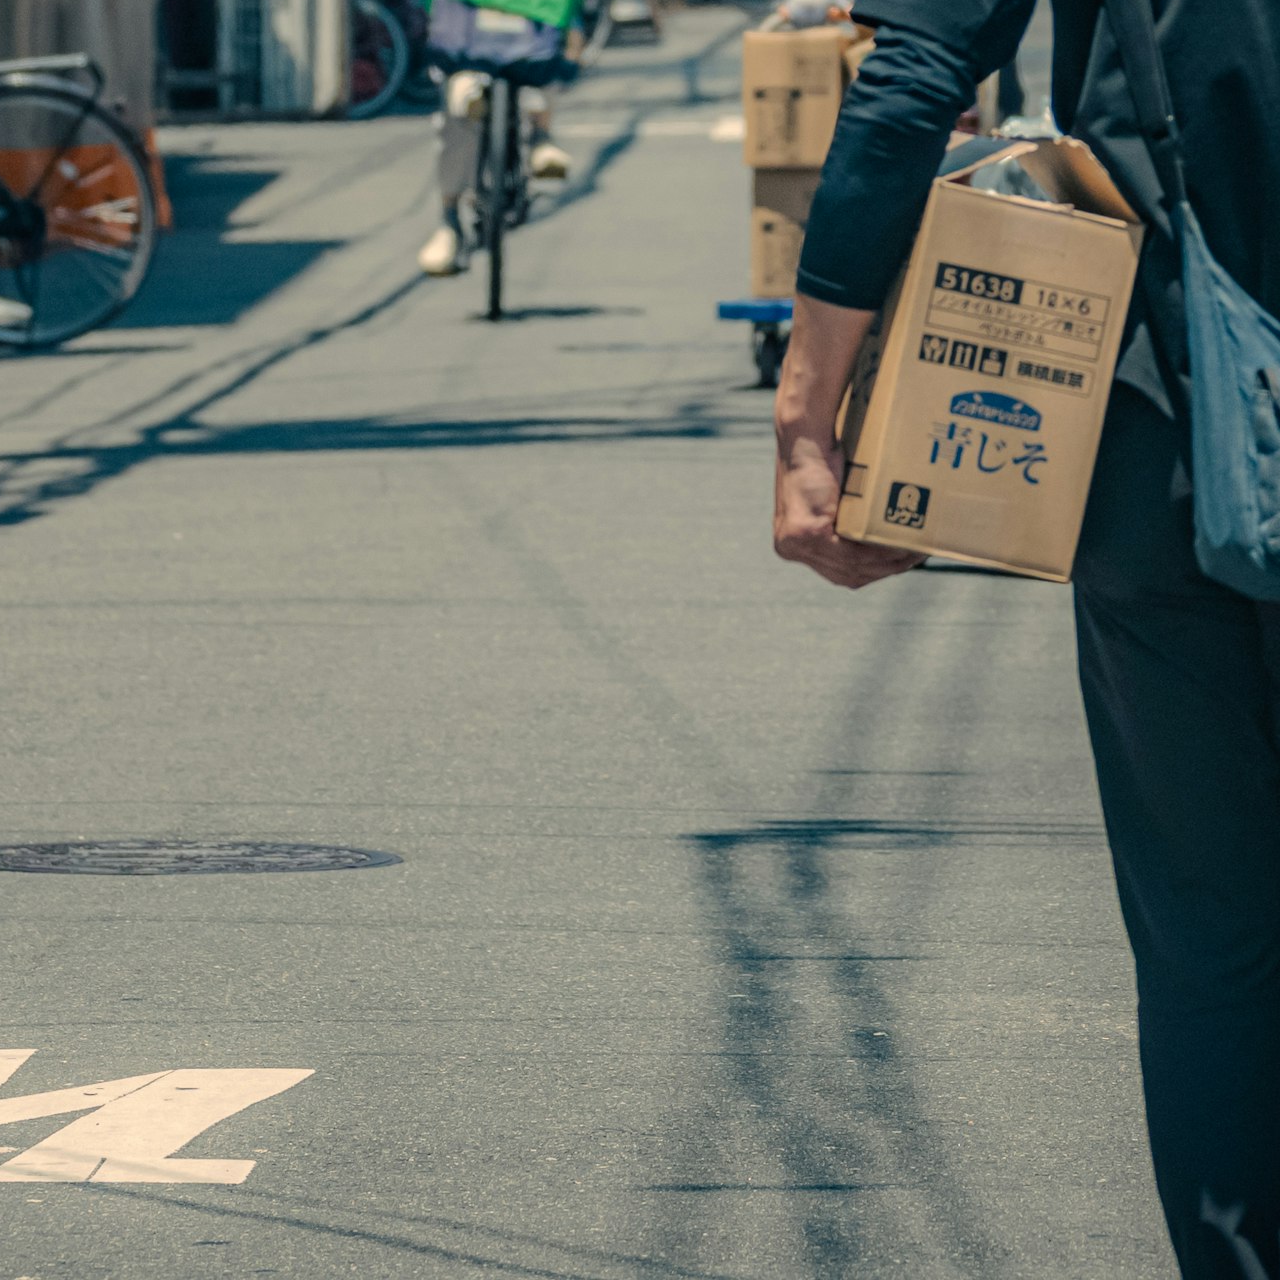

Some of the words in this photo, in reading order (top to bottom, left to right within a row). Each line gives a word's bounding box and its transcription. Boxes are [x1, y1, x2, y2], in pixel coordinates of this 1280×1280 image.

[941, 267, 1016, 302] 51638
[928, 422, 1048, 485] 青じそ
